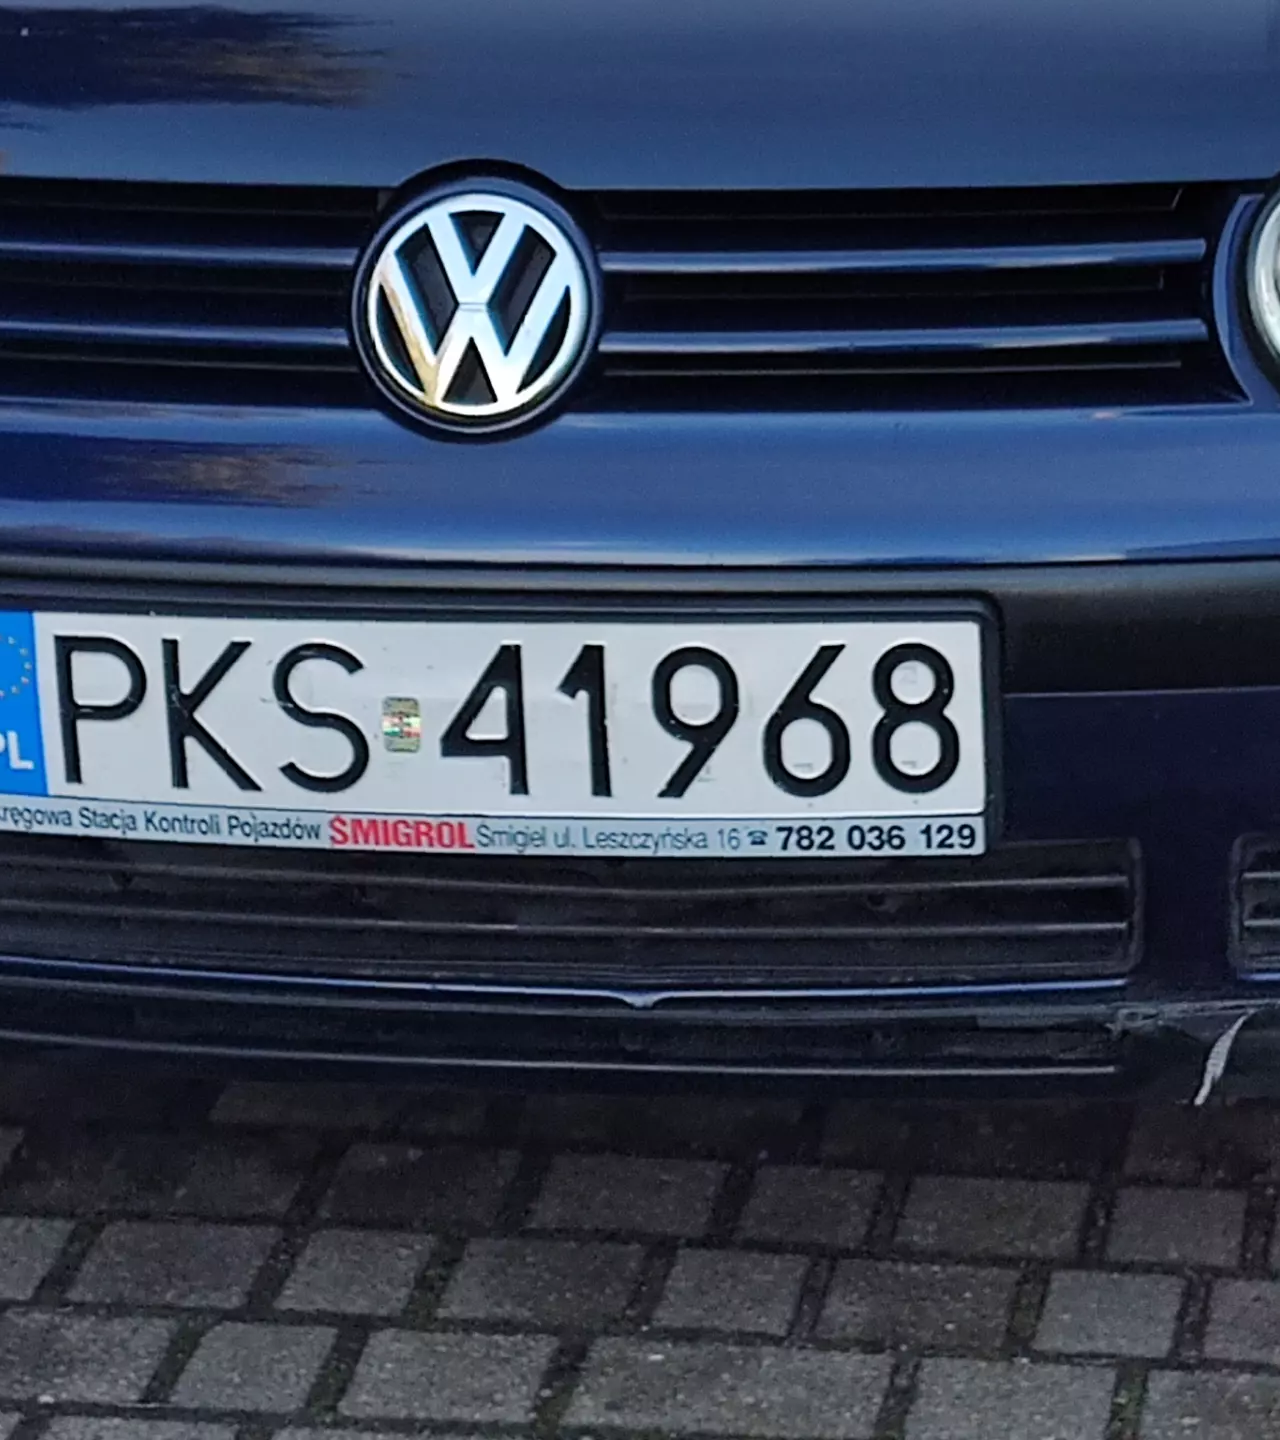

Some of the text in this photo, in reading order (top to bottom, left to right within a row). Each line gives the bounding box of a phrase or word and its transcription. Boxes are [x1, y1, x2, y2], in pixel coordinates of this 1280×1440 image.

[368, 193, 588, 416] VW
[52, 634, 962, 800] PKS 41968
[79, 806, 137, 837] Stacja
[144, 810, 221, 837] Kontroli
[227, 813, 322, 844] Pojazdów
[329, 814, 476, 850] ŚMIGROL
[553, 825, 576, 849] ul.
[582, 827, 708, 855] Leszczyńska
[718, 828, 741, 850] 16
[776, 825, 836, 851] 782
[847, 825, 906, 851] 036
[919, 824, 977, 850] 129
